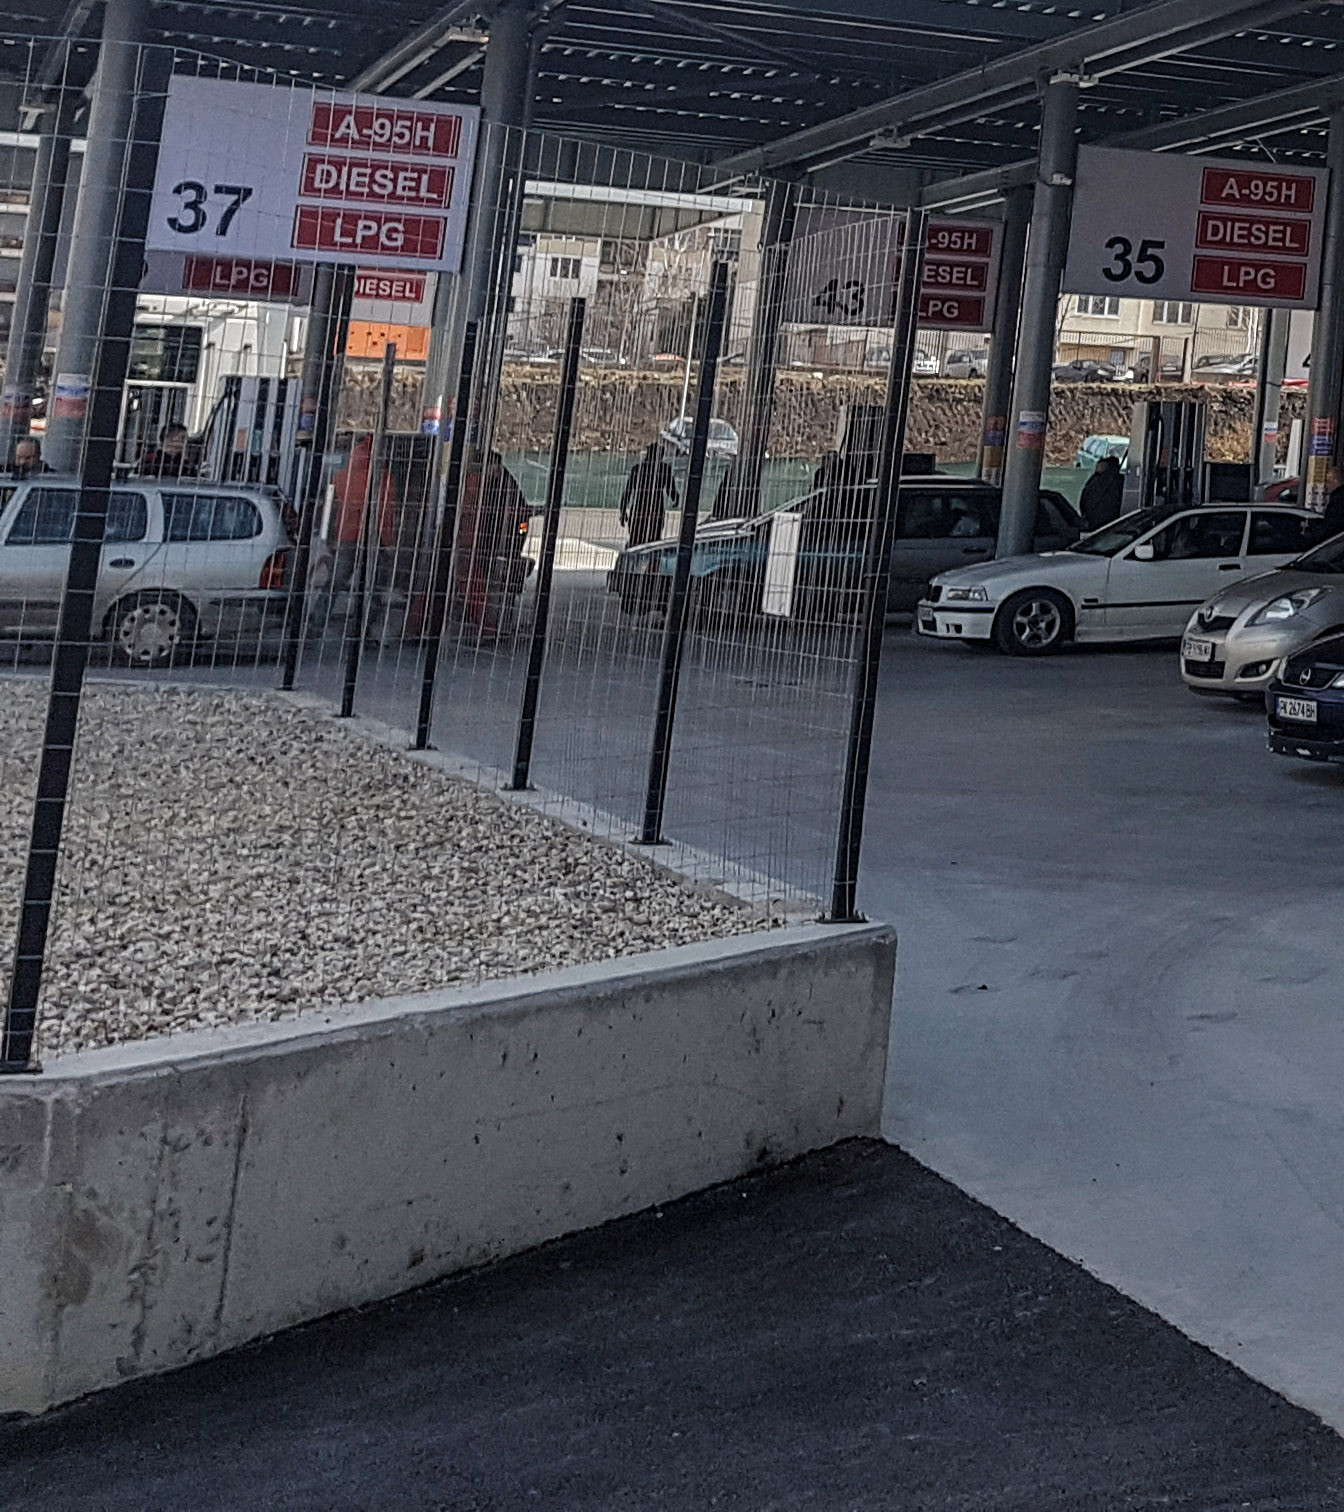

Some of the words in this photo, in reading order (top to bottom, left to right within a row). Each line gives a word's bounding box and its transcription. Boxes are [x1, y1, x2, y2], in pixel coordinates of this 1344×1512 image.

[335, 115, 436, 148] A-95H
[313, 166, 439, 200] DIESEL
[1222, 178, 1297, 205] A-95H
[167, 181, 253, 237] 37
[333, 213, 405, 248] LPG
[930, 231, 977, 250] -95H
[1206, 220, 1299, 248] DIESEL
[215, 265, 268, 286] LPG
[924, 265, 979, 285] ESEL
[1102, 236, 1165, 285] 35
[1223, 264, 1276, 290] LPG
[813, 279, 865, 316] 43
